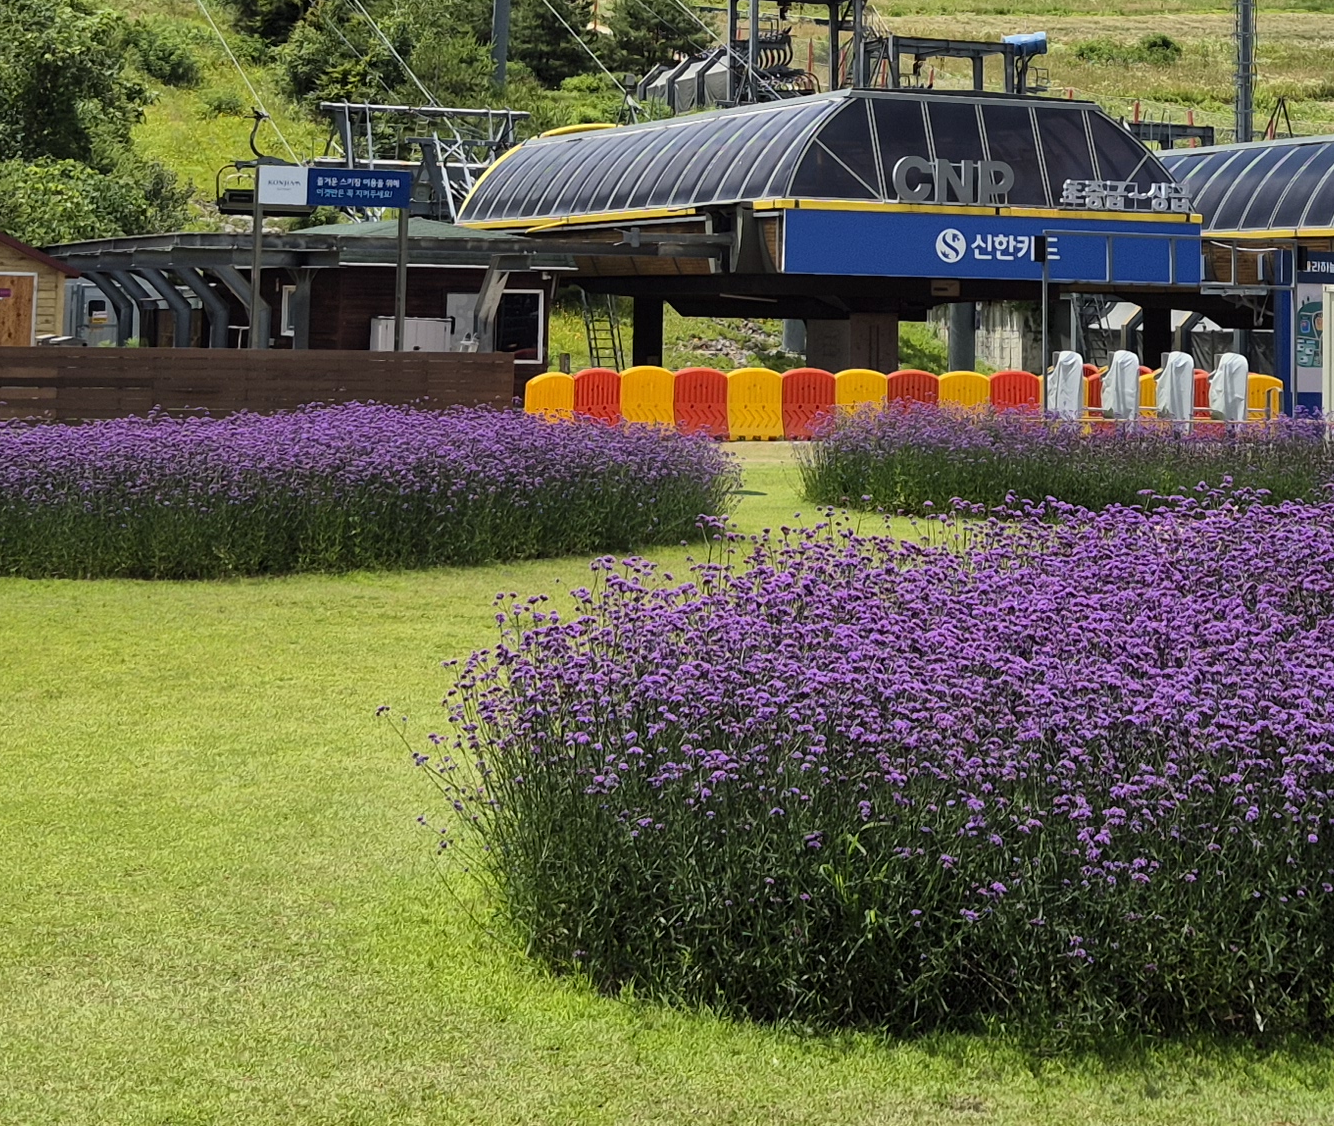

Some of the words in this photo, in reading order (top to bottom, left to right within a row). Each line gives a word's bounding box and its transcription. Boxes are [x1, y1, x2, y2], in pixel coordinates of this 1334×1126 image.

[316, 176, 338, 187] 즐거운
[339, 177, 361, 187] 스키장
[362, 178, 384, 188] 이용을
[385, 179, 400, 188] 위해
[892, 155, 1015, 203] CNP
[316, 188, 344, 198] 이것만은
[346, 189, 353, 198] 꼭
[355, 189, 393, 199] 지켜주세요!
[970, 233, 1062, 261] 신한카드
